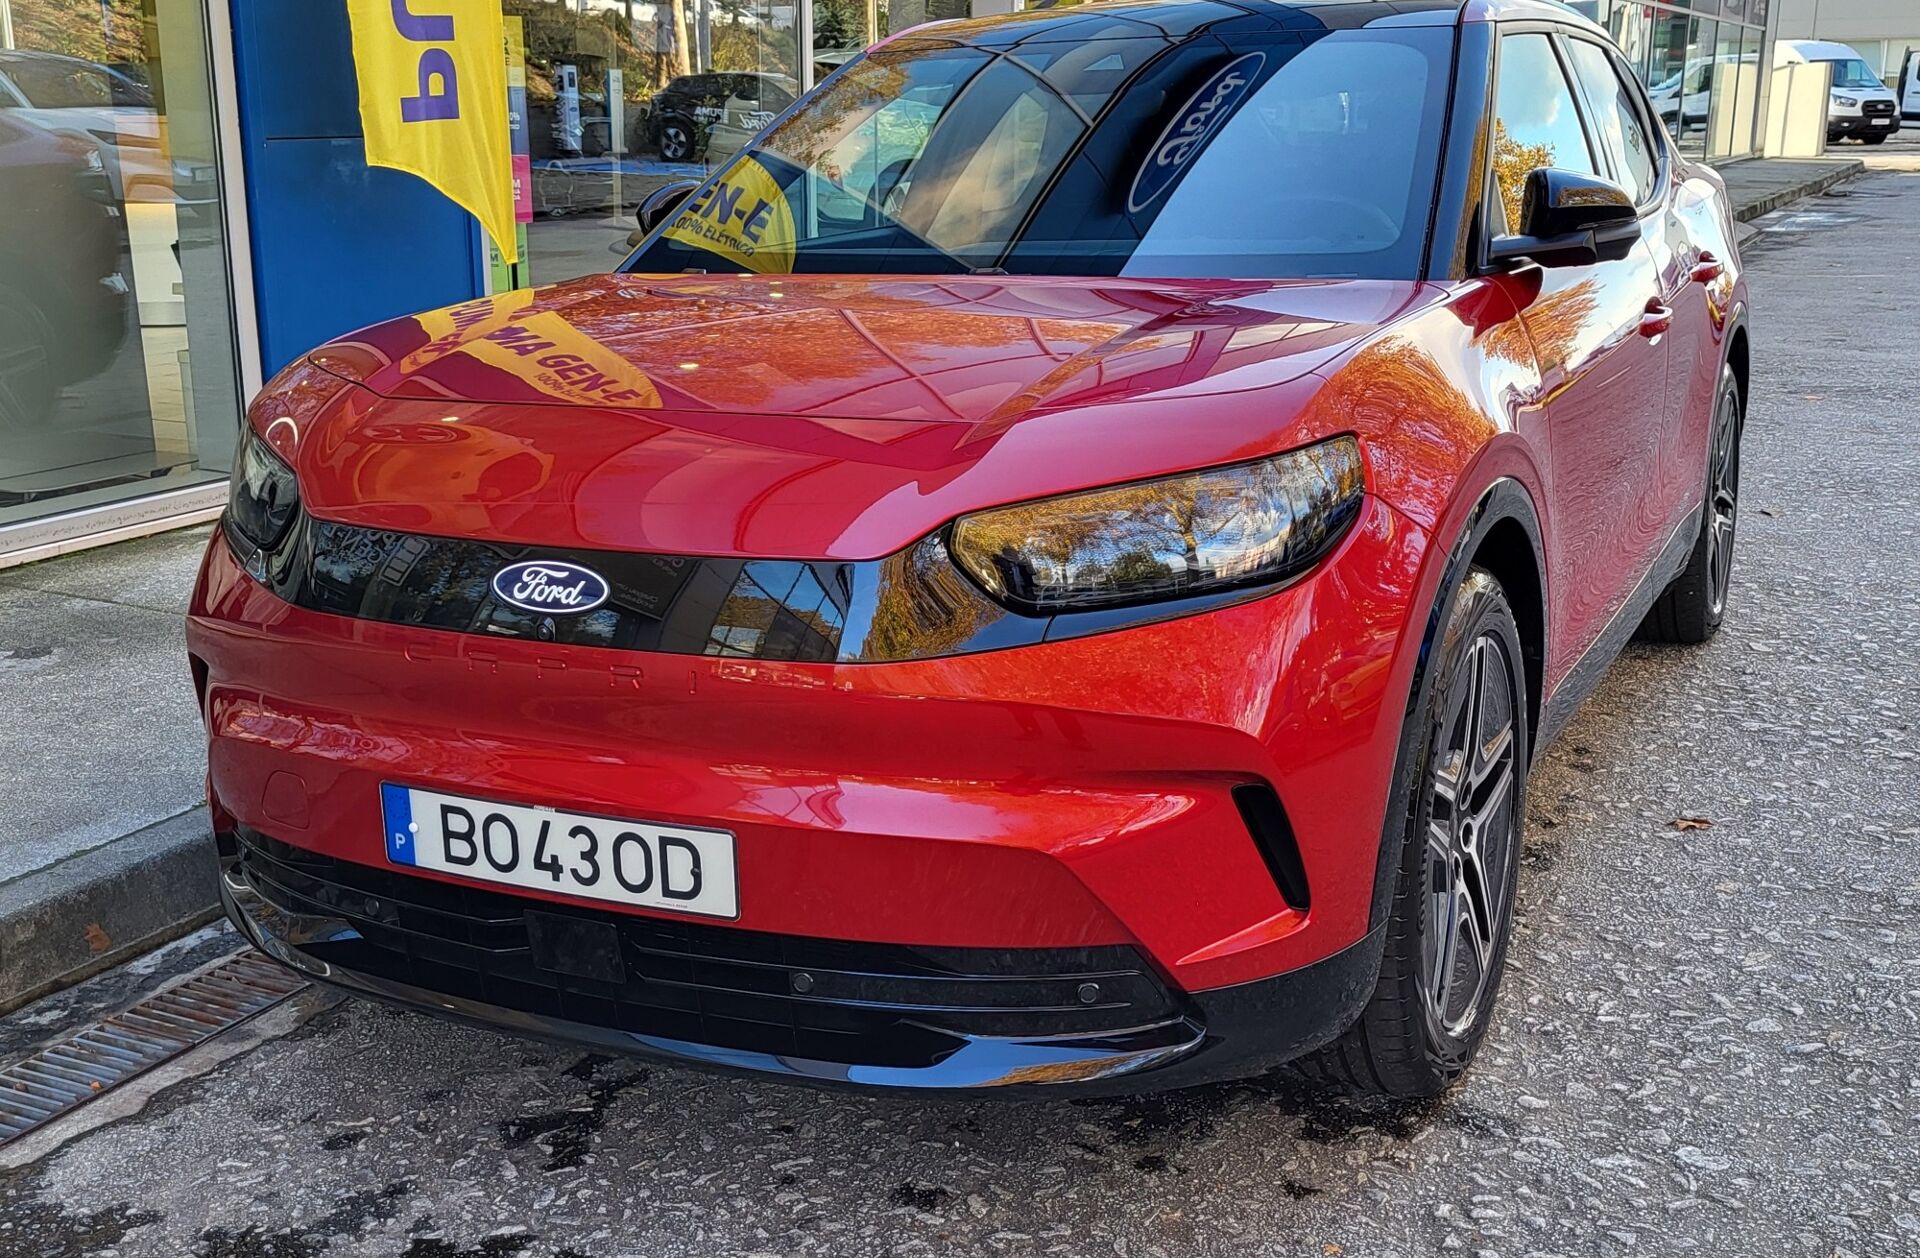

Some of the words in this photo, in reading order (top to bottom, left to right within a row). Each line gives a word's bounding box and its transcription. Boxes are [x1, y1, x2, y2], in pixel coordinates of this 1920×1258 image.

[513, 565, 585, 605] Ford
[395, 832, 406, 850] P
[439, 803, 520, 874] BO
[532, 819, 601, 887] 43
[613, 831, 703, 901] OD
